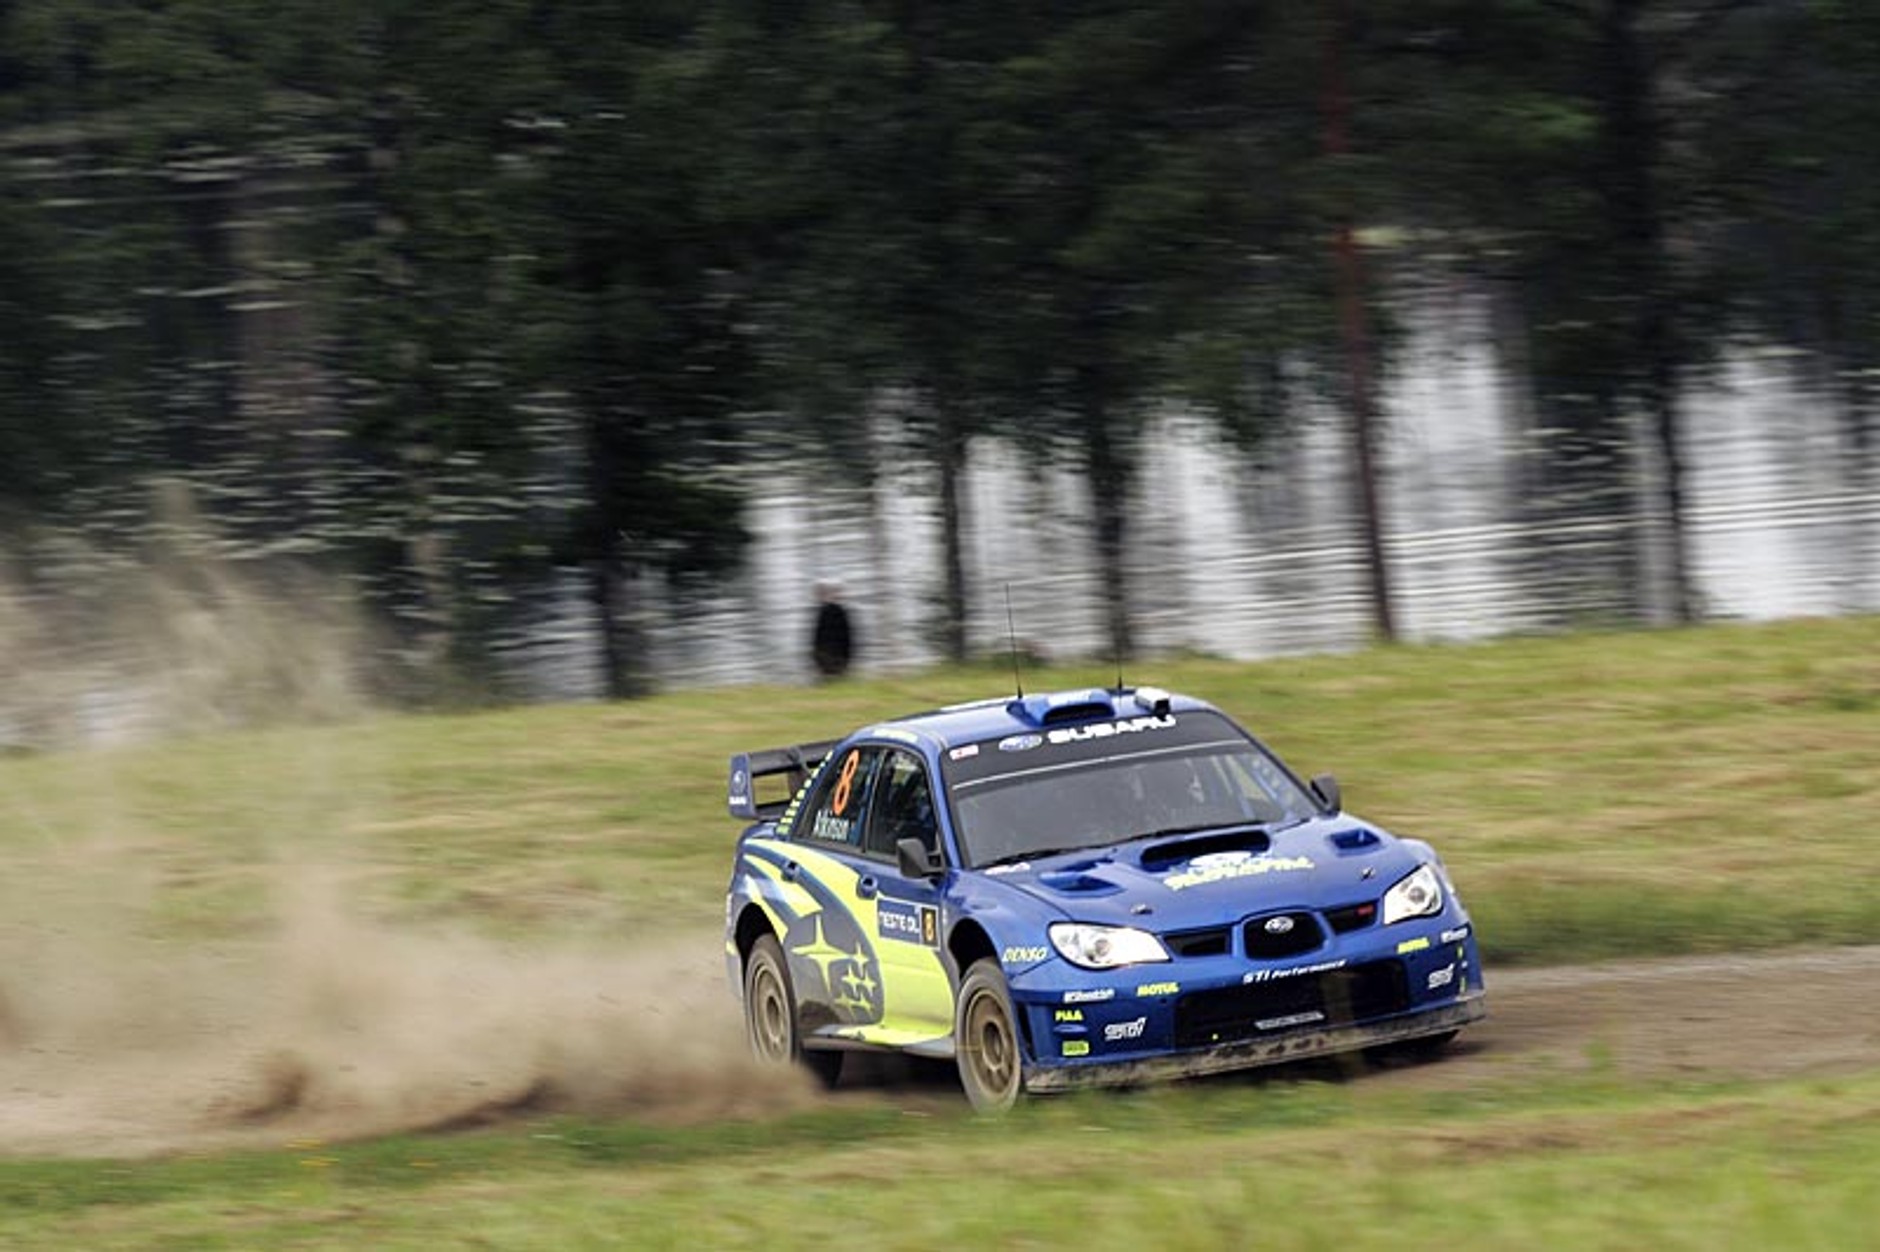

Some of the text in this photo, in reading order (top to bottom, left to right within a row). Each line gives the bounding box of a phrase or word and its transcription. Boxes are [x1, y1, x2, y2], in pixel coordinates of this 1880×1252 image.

[1048, 714, 1176, 743] SUBARU
[832, 749, 860, 816] 8
[1243, 969, 1270, 985] STI
[1055, 1010, 1084, 1022] PIAA
